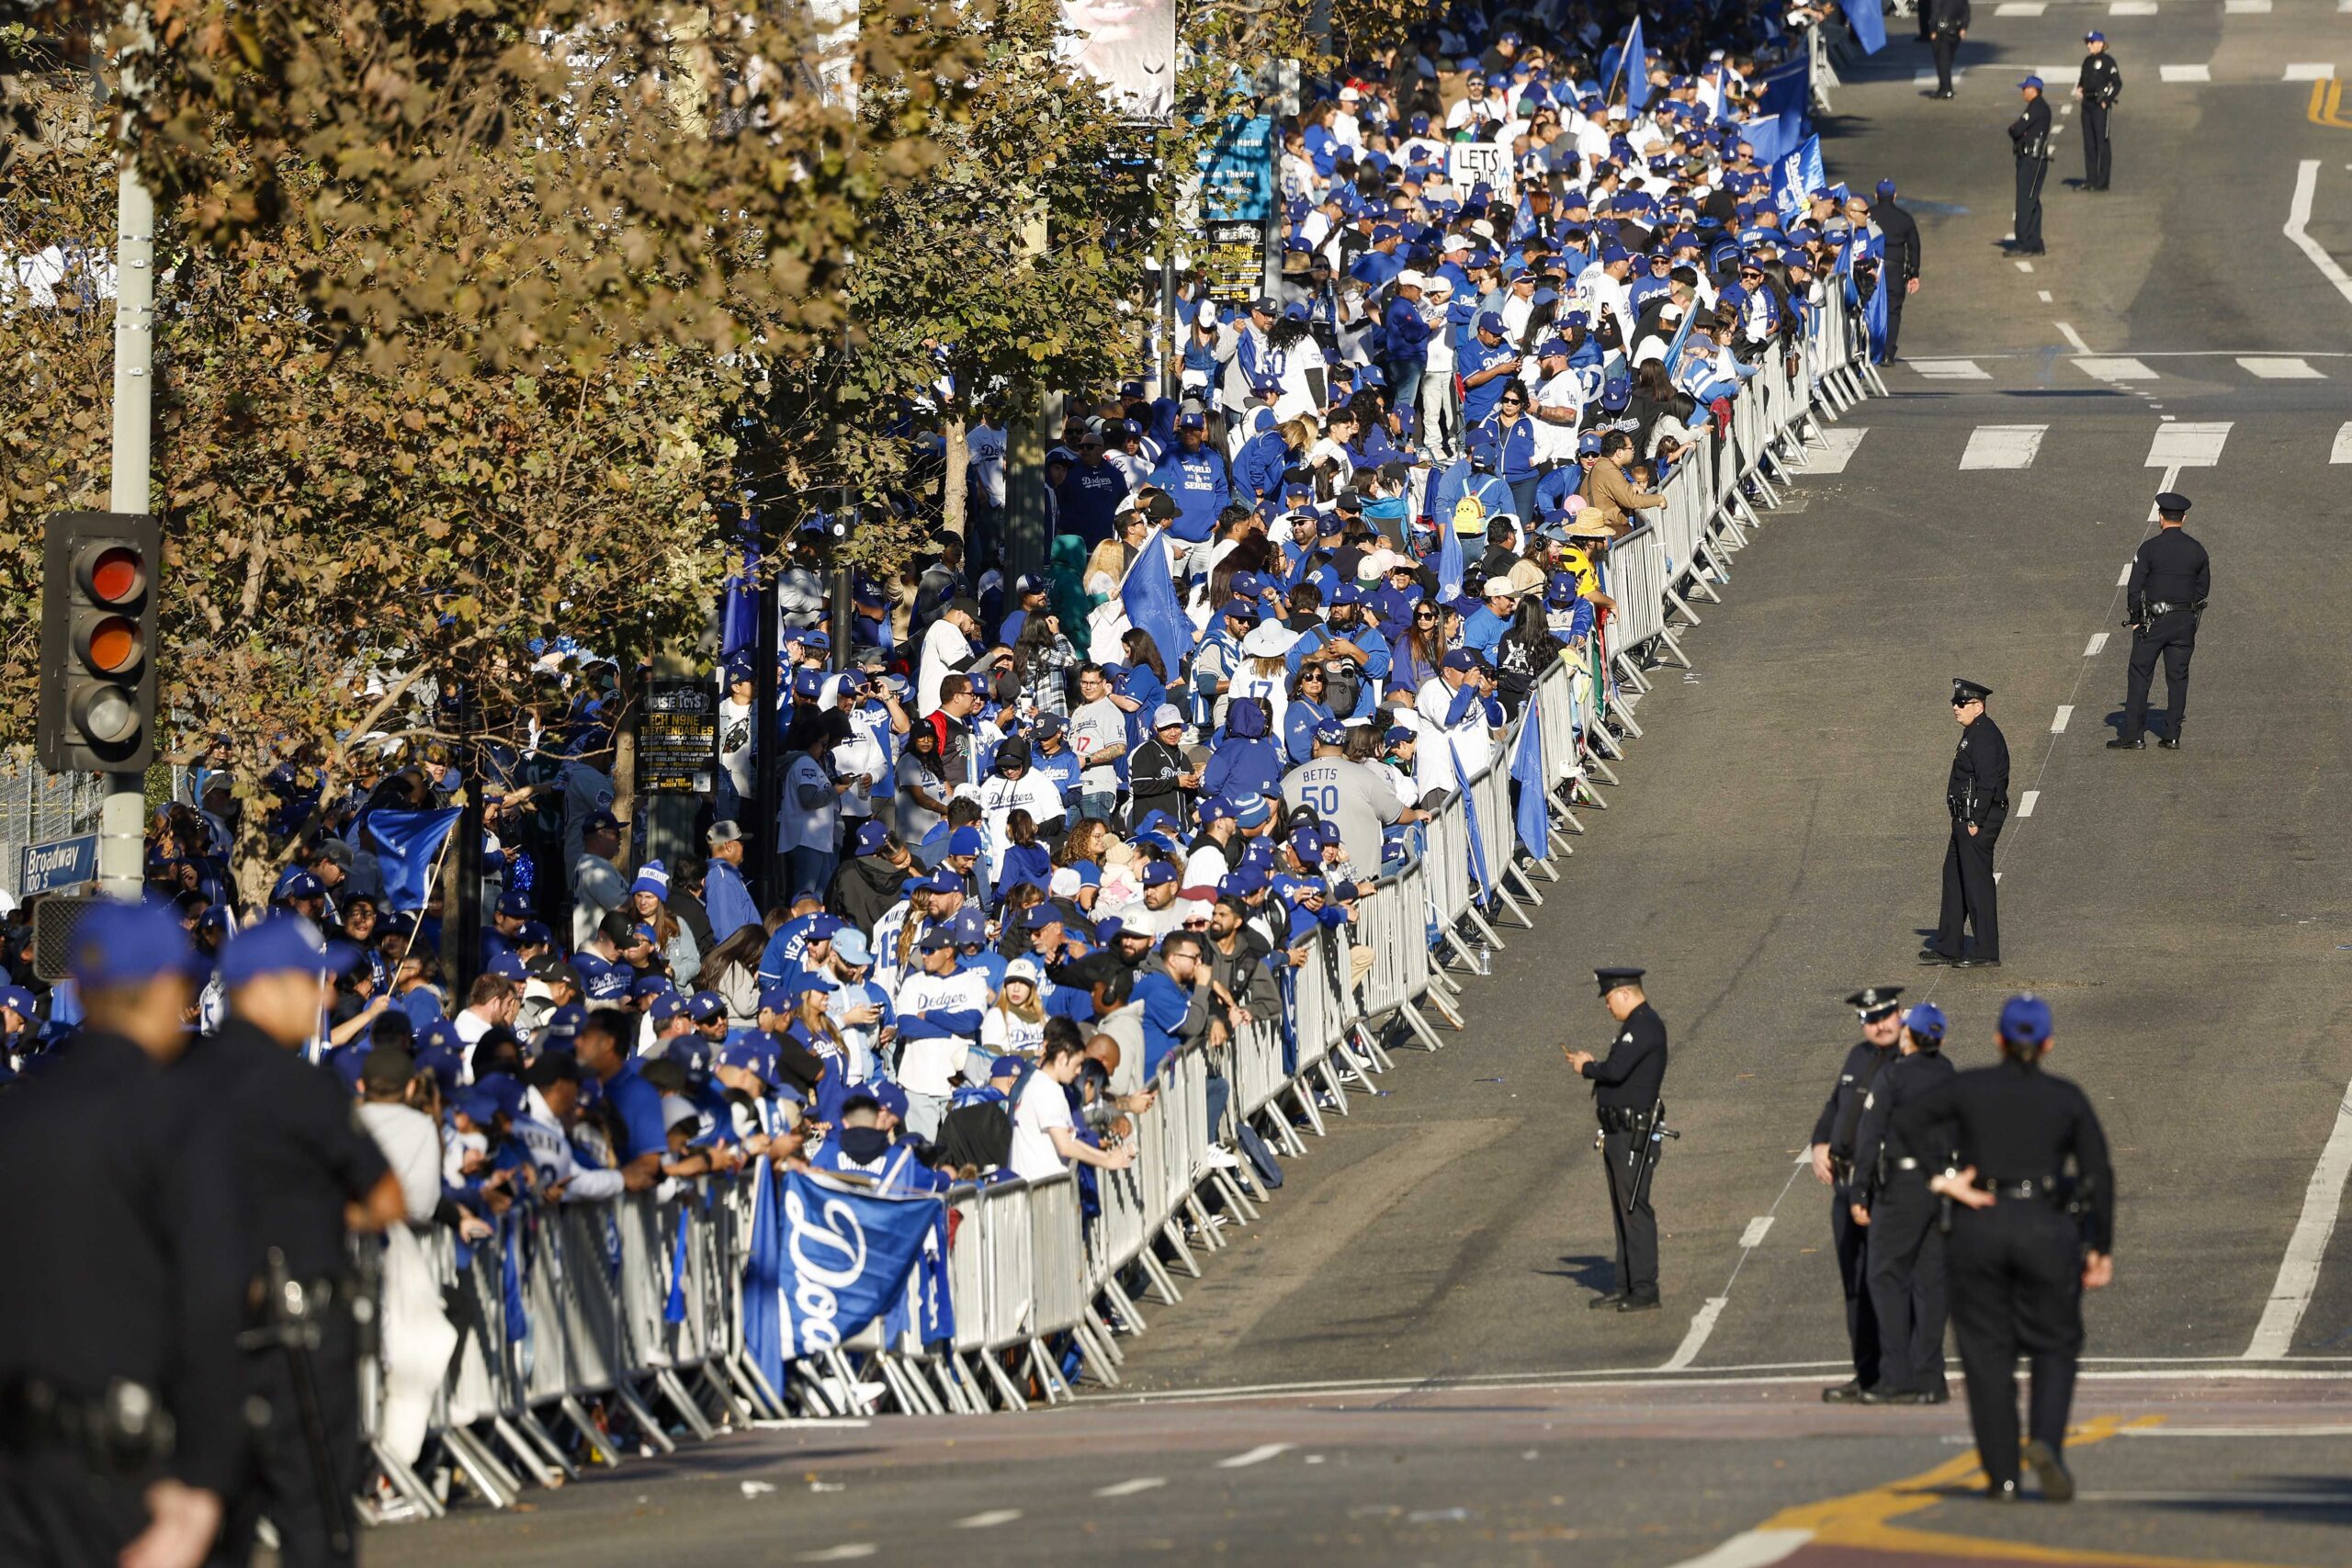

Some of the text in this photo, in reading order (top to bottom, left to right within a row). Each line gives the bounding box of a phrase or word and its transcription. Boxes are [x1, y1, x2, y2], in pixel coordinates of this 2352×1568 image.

[1237, 139, 1262, 147] Market
[1196, 154, 1222, 163] hedral
[1459, 149, 1498, 173] LETS
[1226, 170, 1255, 178] Theatre
[1566, 391, 1577, 405] LA
[1186, 414, 1193, 425] LA
[1517, 425, 1526, 437] LA
[1182, 464, 1212, 474] WORLD
[1081, 477, 1112, 489] Dodgers
[1183, 481, 1213, 491] SERIES
[1560, 582, 1567, 592] LA
[808, 679, 816, 690] LA
[978, 677, 984, 688] LA
[1249, 680, 1273, 699] 17
[673, 715, 699, 726] N9NE
[1117, 725, 1126, 739] LA
[1077, 736, 1091, 752] 17
[1044, 766, 1069, 779] dgers
[1303, 768, 1338, 783] BETTS
[989, 792, 1035, 810] Dodgers
[1301, 784, 1339, 816] 50
[861, 834, 869, 846] LA
[1309, 838, 1317, 851] LA
[28, 845, 79, 874] Broadway
[26, 871, 49, 893] 100 S
[307, 875, 316, 889] LA
[1219, 875, 1228, 889] LA
[884, 908, 905, 926] MUNC
[967, 919, 976, 931] LA
[590, 976, 605, 991] Los
[702, 998, 714, 1010] LA
[918, 991, 967, 1010] Dodgers
